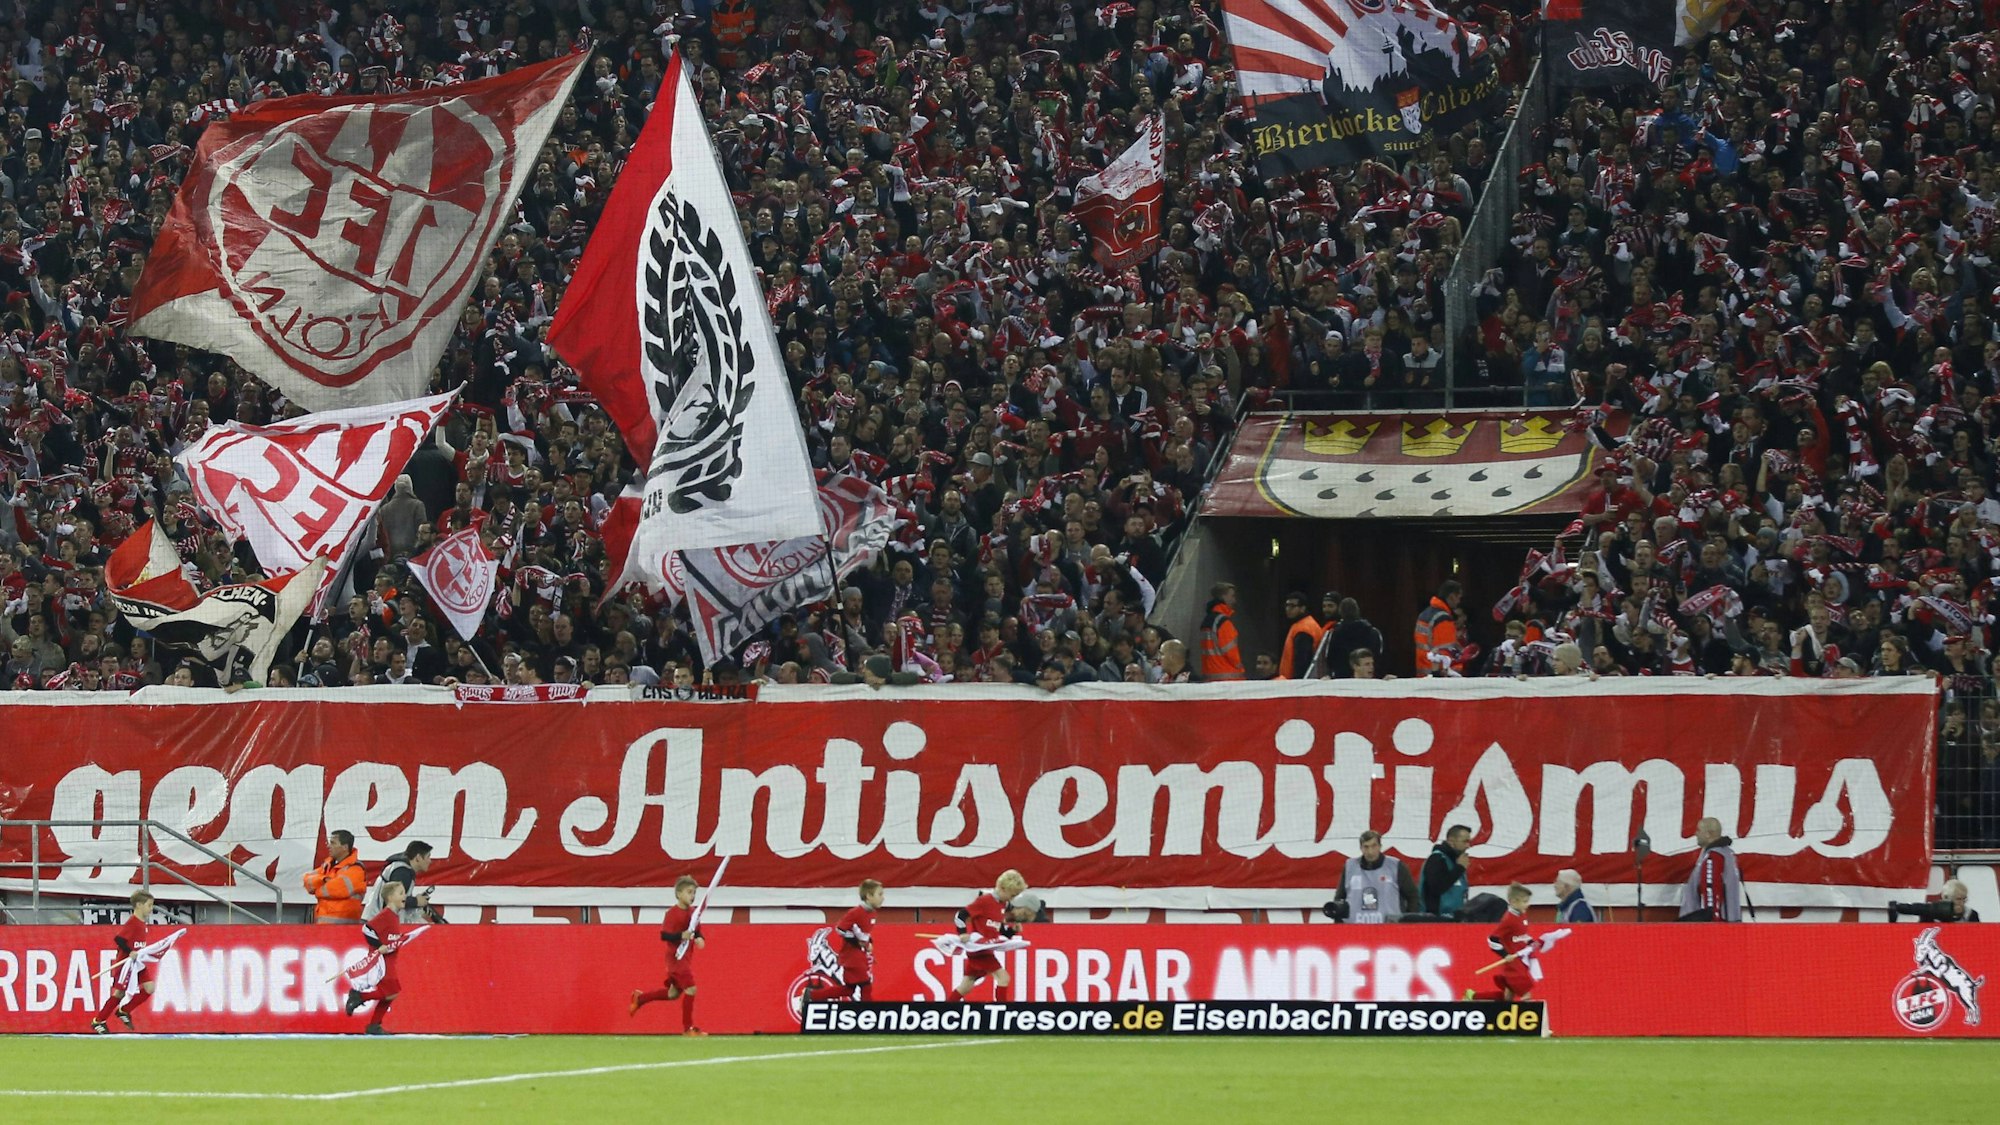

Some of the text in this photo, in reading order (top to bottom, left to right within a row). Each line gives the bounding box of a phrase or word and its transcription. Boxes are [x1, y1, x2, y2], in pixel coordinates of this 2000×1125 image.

[1252, 106, 1402, 155] Bierböcke
[211, 585, 268, 607] CHEN.
[49, 717, 1893, 885] gegen Antisemitismus
[804, 1002, 1539, 1031] EisenbachTresore.de EisenbachTresore.de
